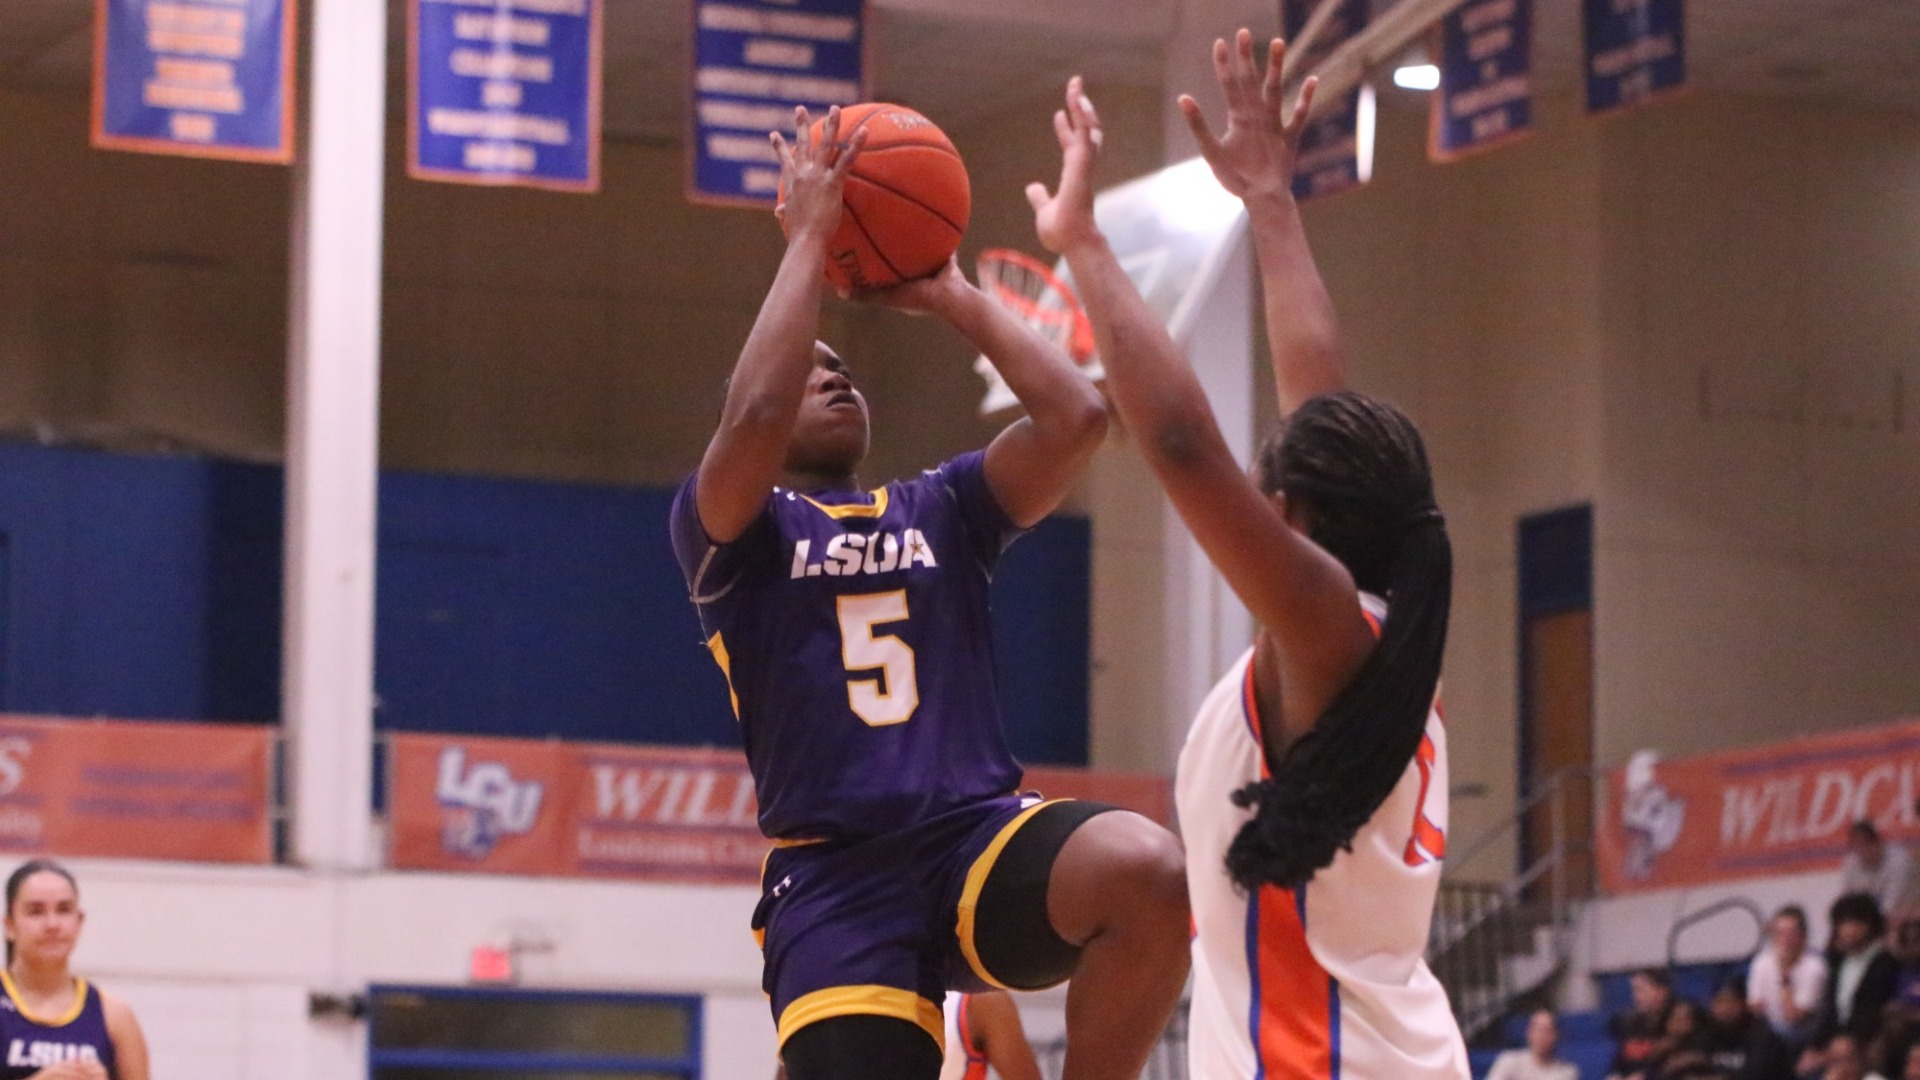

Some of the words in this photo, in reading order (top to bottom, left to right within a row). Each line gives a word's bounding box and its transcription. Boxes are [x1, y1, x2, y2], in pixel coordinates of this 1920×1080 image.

[790, 528, 938, 579] LSUA
[836, 588, 919, 727] 5
[437, 746, 543, 834] LCU
